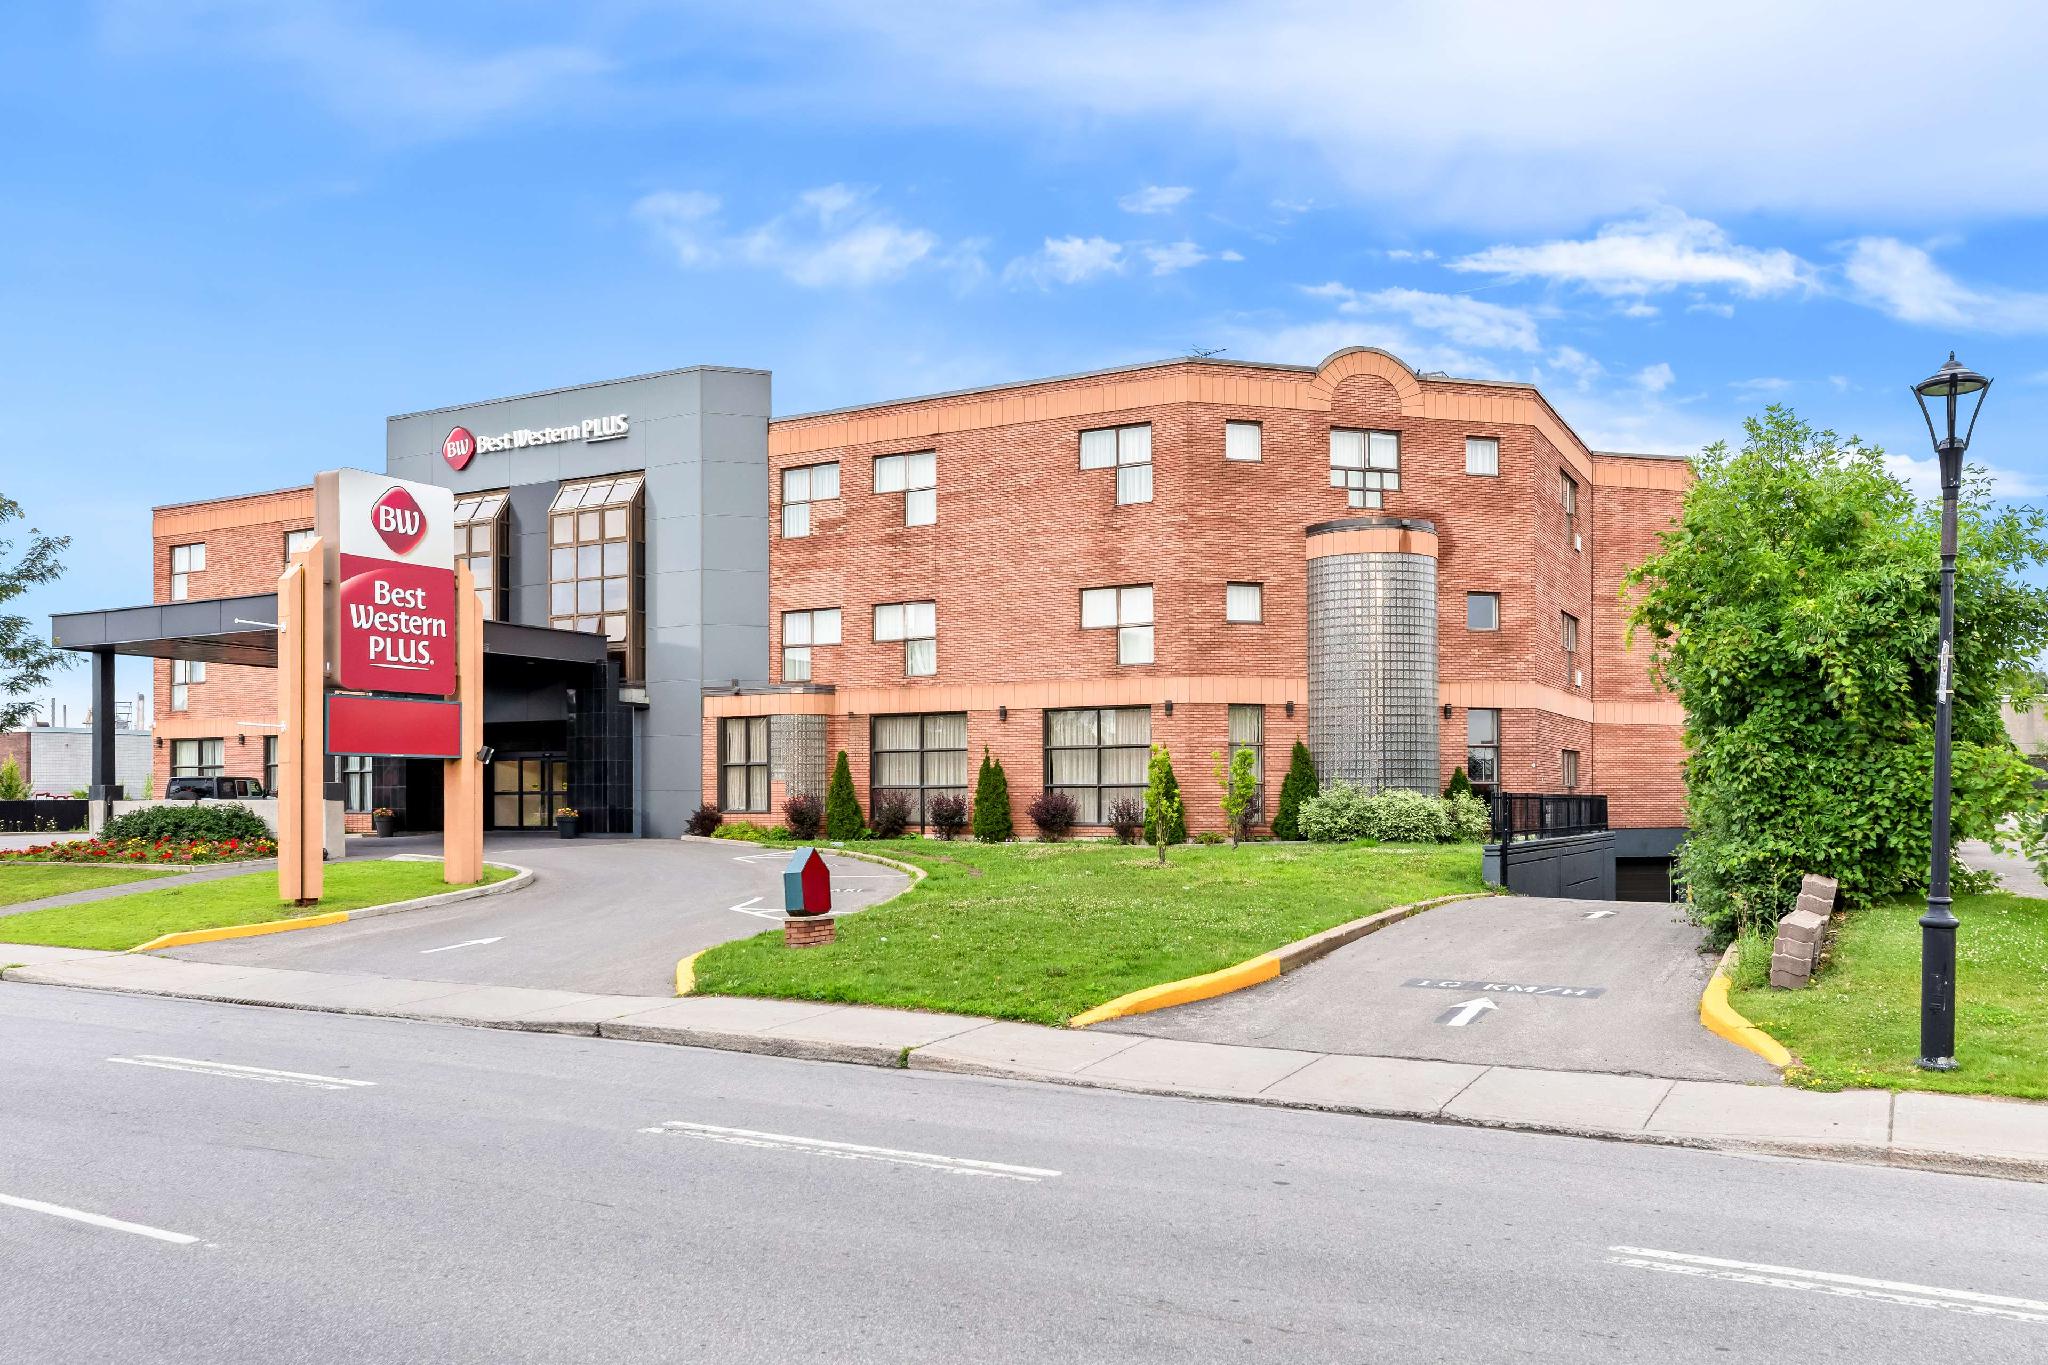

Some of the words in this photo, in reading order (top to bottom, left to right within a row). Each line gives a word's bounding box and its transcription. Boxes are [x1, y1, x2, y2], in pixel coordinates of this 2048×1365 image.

[446, 438, 470, 459] BW
[476, 433, 513, 454] Best
[513, 424, 581, 449] Western
[581, 413, 629, 439] PLUS
[379, 505, 420, 535] BW
[374, 580, 427, 610] Best
[350, 603, 447, 638] Western
[1482, 983, 1588, 996] KM/H
